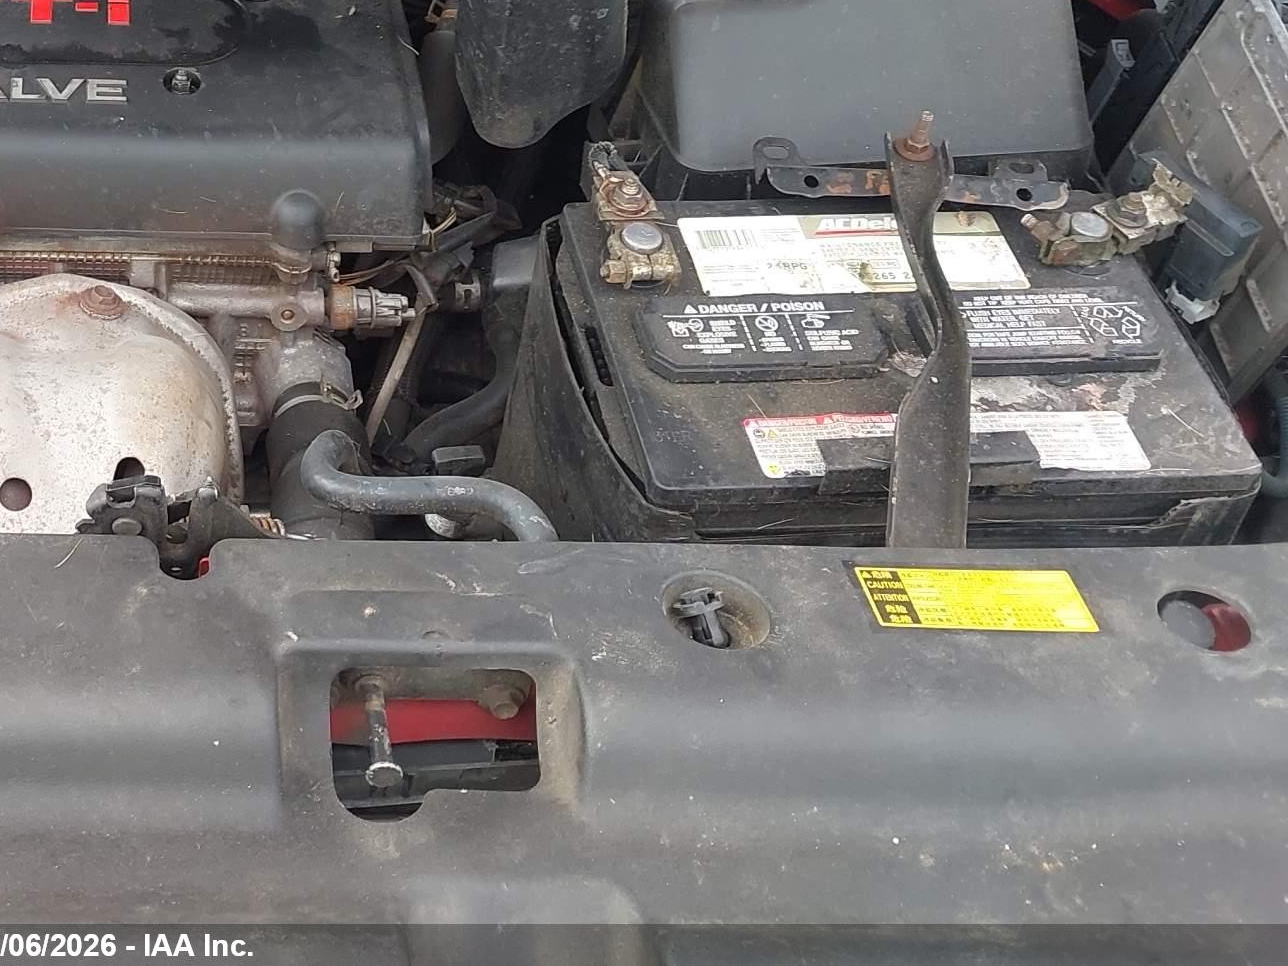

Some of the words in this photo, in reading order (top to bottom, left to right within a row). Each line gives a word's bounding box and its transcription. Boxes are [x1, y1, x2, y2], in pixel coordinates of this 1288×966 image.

[697, 303, 758, 314] DANGER
[770, 301, 825, 312] POISON
[866, 581, 904, 589] CAUTION
[873, 593, 910, 602] ATTENTION
